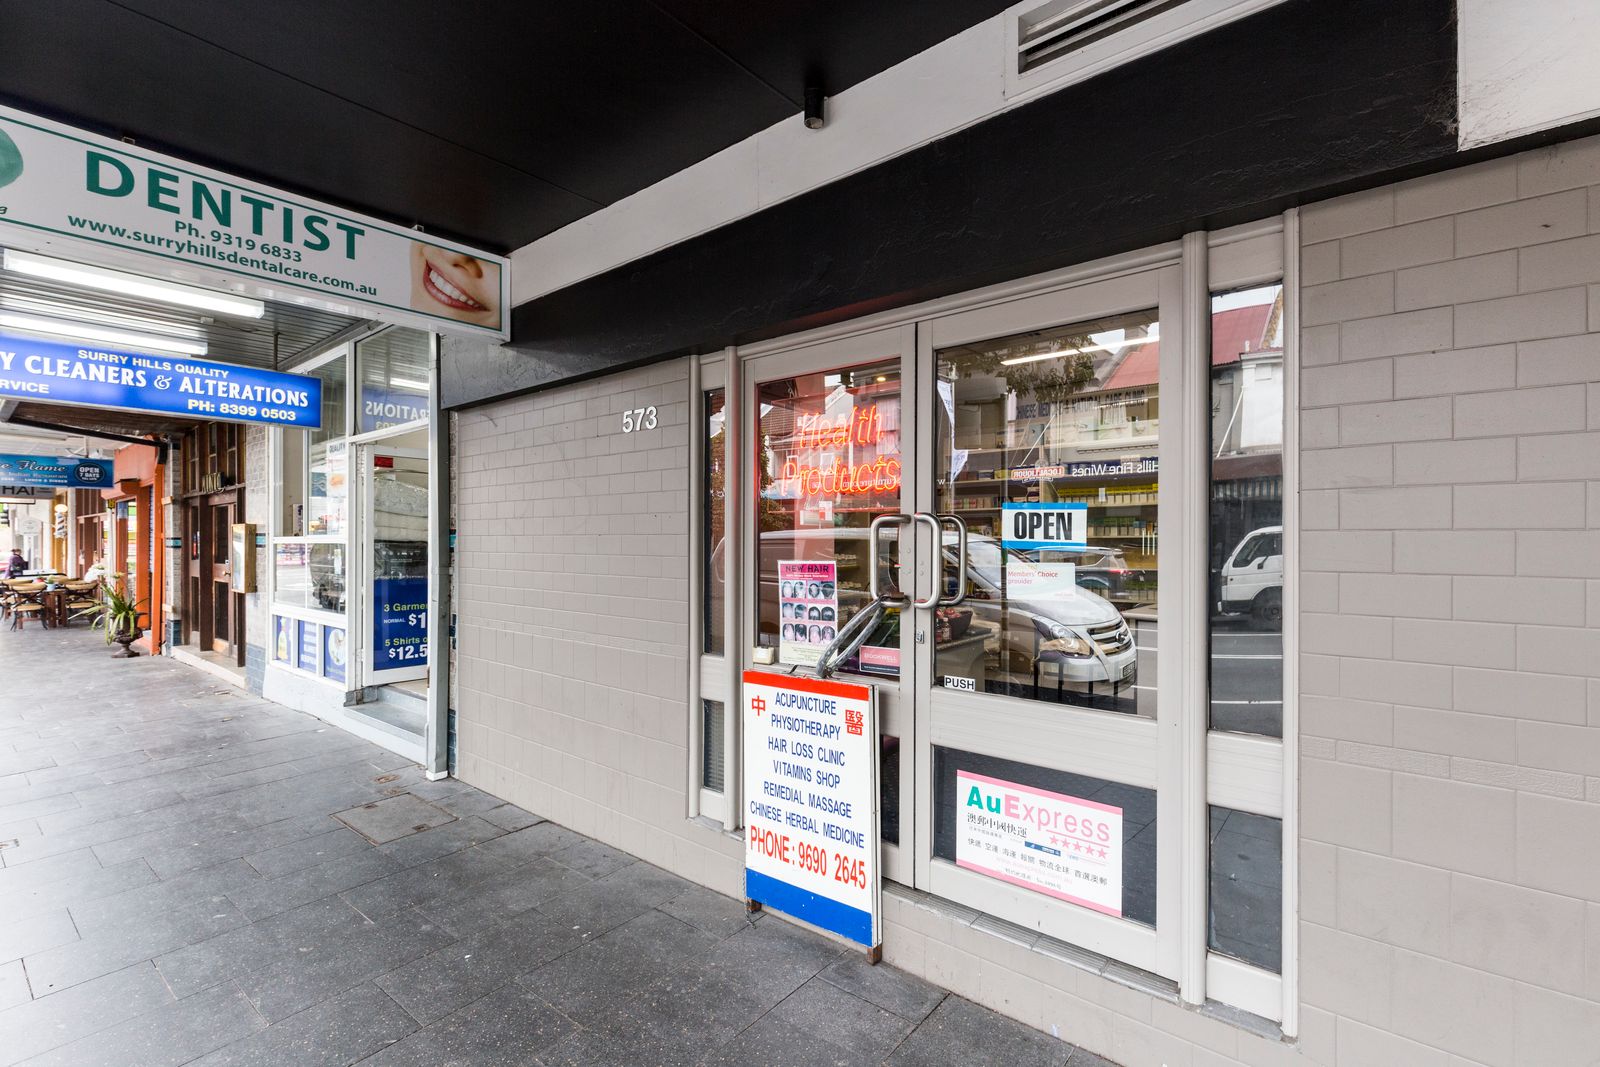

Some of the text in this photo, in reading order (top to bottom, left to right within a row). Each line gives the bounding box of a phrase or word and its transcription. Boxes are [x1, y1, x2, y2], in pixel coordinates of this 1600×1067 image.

[86, 150, 365, 260] DENTIST
[68, 215, 377, 296] www.surryhillsdentalcare.com.au
[175, 220, 302, 262] Ph. 9319 6833
[78, 350, 229, 378] SURRY HILLS QUALITY
[25, 355, 148, 388] CLEANERS
[154, 374, 172, 390] &
[179, 376, 309, 408] ALTERATIONS
[187, 399, 296, 421] PH: 8399 0503
[622, 406, 659, 433] 573
[799, 405, 883, 449] Health
[780, 456, 900, 497] Products
[1013, 511, 1072, 541] OPEN
[785, 565, 829, 573] NEW HAIR
[383, 603, 390, 612] 3
[393, 637, 418, 646] Shirts
[945, 677, 975, 690] PUSH
[751, 695, 766, 717] 中
[775, 692, 837, 716] ACUPUNCTURE
[771, 713, 841, 740] PHYSIOTHERAPY
[845, 709, 864, 736] 醫
[768, 736, 846, 767] HAIR LOSS CLINIC
[773, 760, 840, 789] VITAMINS SHOP
[763, 780, 852, 819] REMEDIAL MASSAGE
[967, 785, 1110, 842] AuExpress
[750, 800, 865, 849] CHINESE HERBAL MEDICINE
[750, 825, 867, 890] PHONE: 9690 2645
